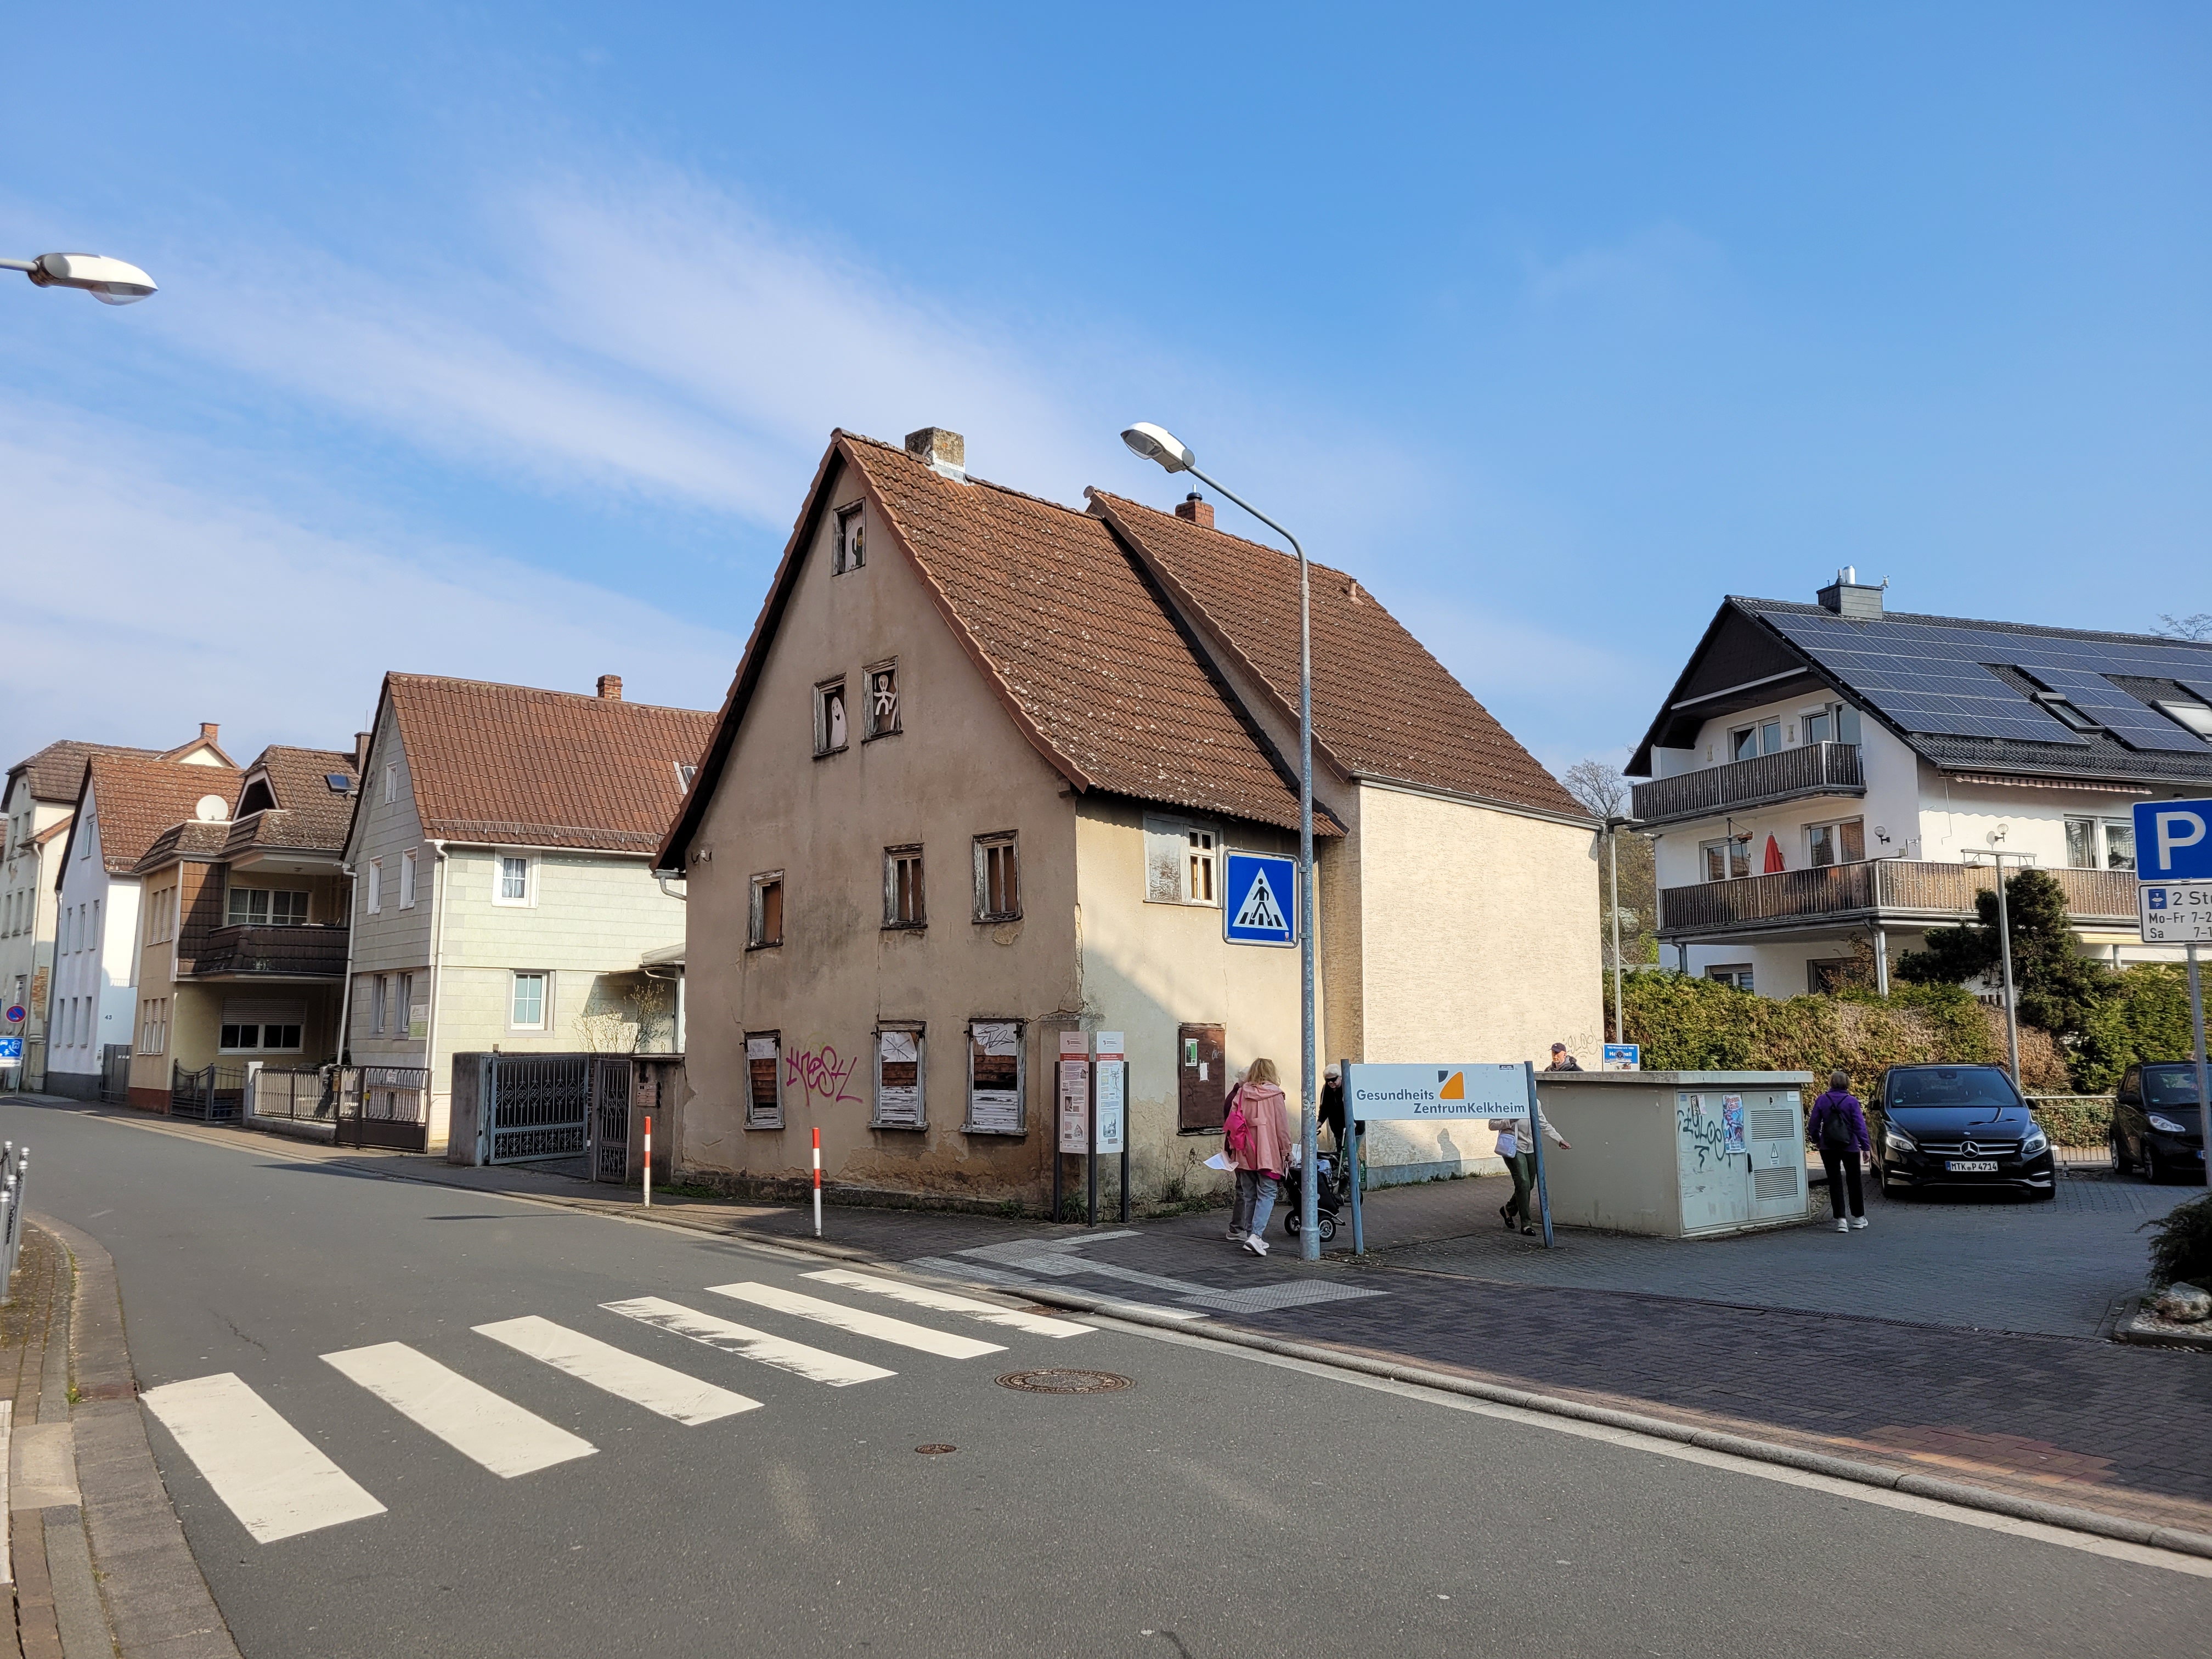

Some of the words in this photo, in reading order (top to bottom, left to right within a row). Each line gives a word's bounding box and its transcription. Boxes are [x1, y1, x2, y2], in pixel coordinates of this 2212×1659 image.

[2156, 811, 2206, 870] P
[2172, 891, 2183, 906] 2
[2188, 891, 2212, 905] St
[2149, 912, 2185, 924] Mo-Fr
[2150, 927, 2164, 939] Sa
[1356, 1088, 1434, 1101] Gesundheits
[1413, 1101, 1525, 1114] ZentrumKelkheim
[1951, 1163, 1966, 1171] MTK
[1972, 1163, 1977, 1171] P
[1978, 1163, 1997, 1171] 4714
